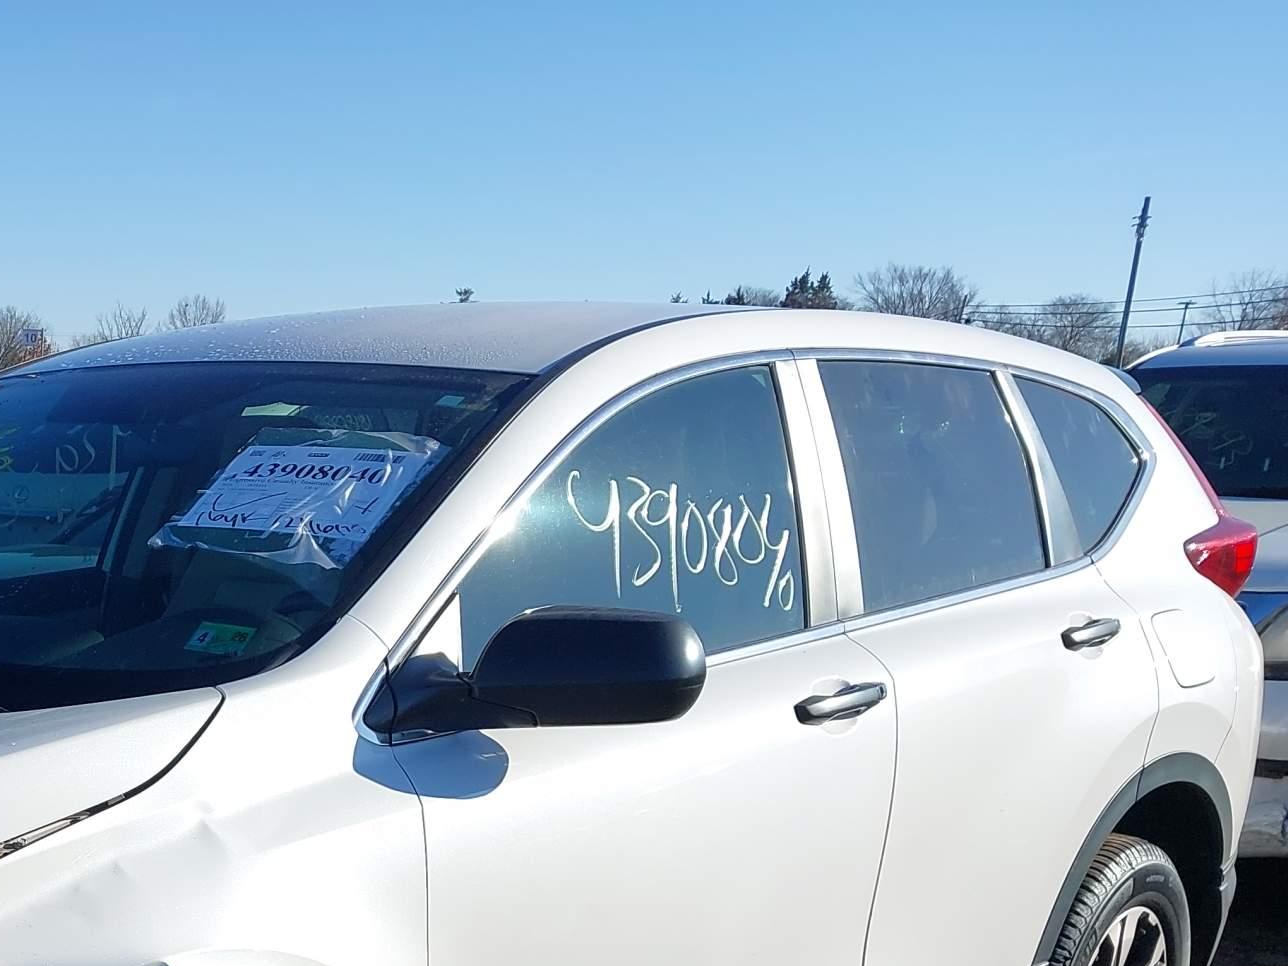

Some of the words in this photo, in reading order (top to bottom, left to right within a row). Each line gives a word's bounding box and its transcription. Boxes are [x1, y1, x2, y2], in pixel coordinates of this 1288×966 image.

[24, 333, 36, 343] 10
[243, 462, 386, 485] 43908040
[566, 470, 795, 613] 43908040
[196, 631, 210, 644] 4
